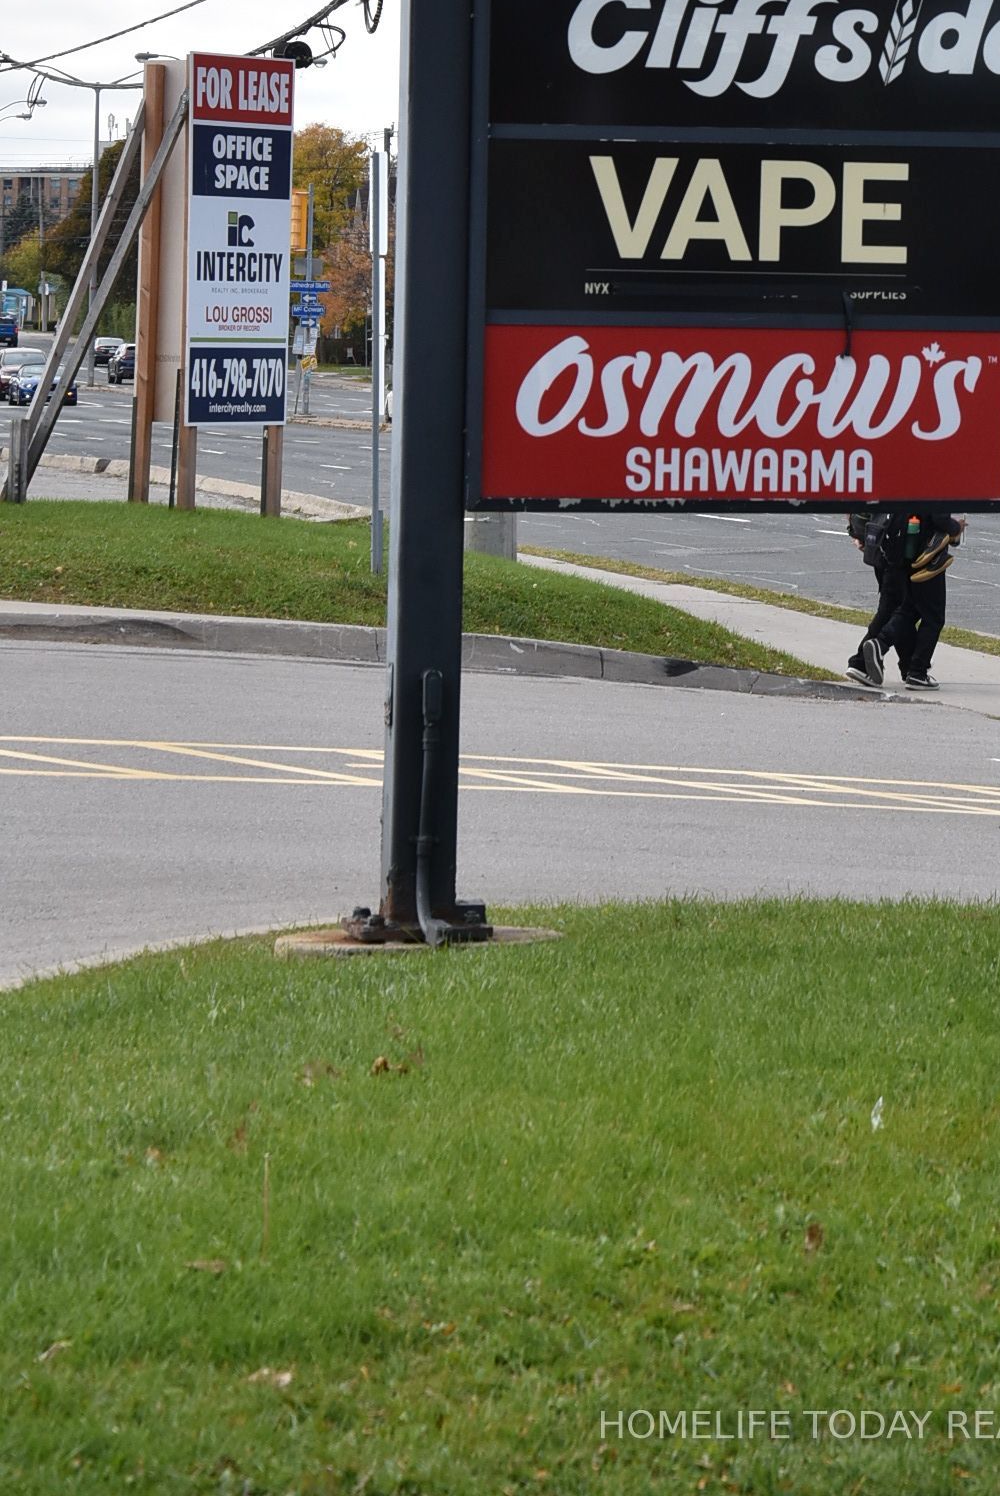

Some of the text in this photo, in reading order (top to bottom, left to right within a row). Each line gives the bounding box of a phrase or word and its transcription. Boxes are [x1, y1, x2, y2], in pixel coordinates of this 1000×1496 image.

[196, 67, 290, 114] FOR LEASE
[212, 134, 273, 162] OFFICE
[214, 164, 270, 191] SPACE
[590, 156, 909, 264] VAPE
[196, 251, 283, 283] INTERCITY
[584, 282, 609, 294] NYX
[206, 306, 273, 324] LOU GROSSI
[191, 358, 284, 398] 416-798-7070
[209, 401, 267, 415] intercityrealty.com
[626, 447, 873, 493] SHAWARMA
